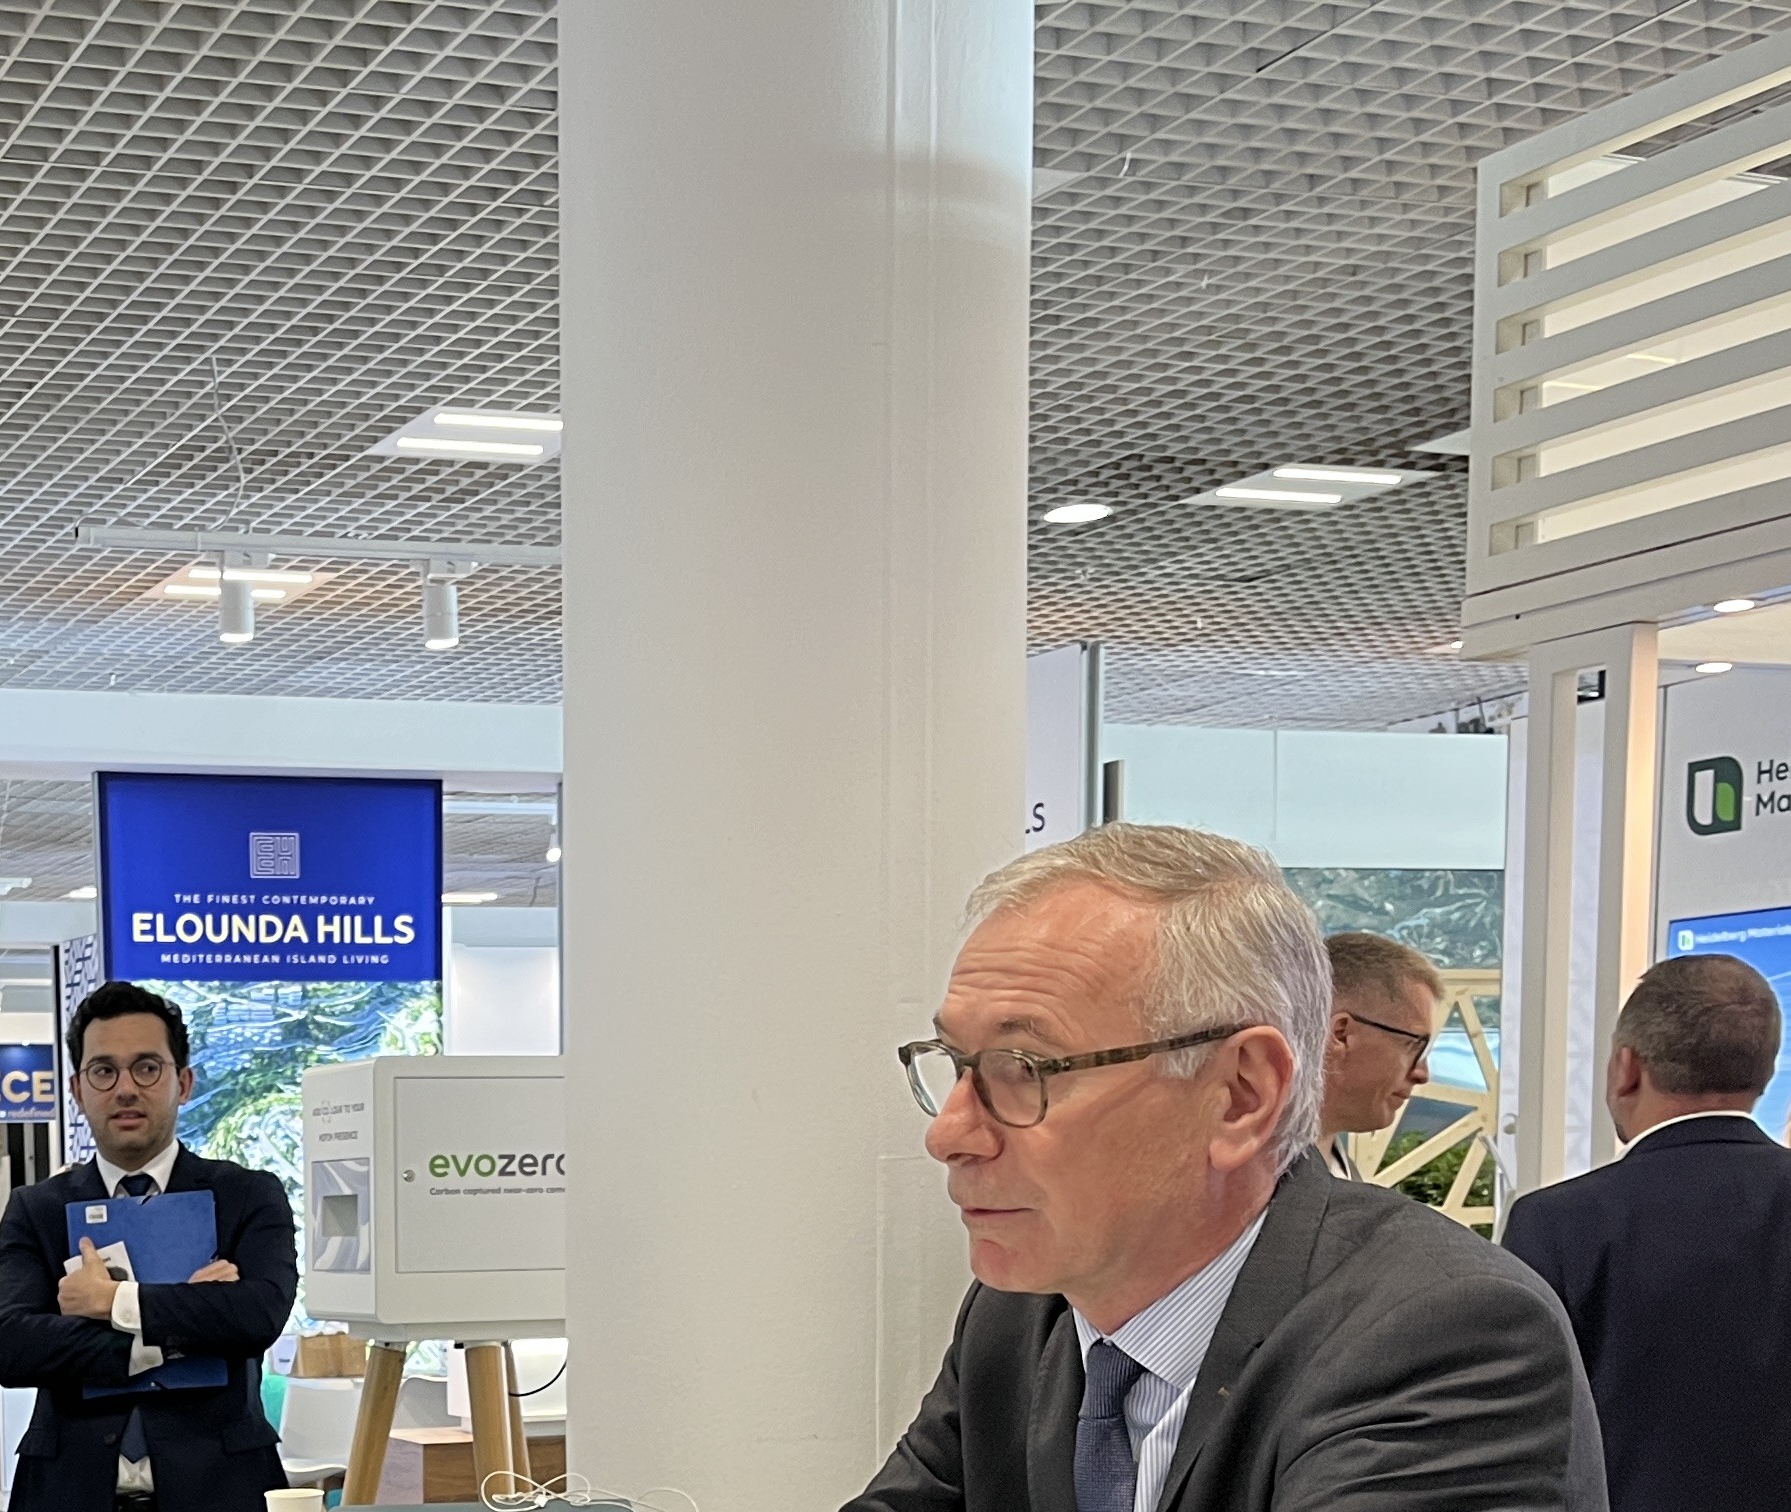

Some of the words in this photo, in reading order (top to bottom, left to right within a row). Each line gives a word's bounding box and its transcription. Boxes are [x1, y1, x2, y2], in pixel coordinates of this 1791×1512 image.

[174, 894, 200, 904] THE
[207, 894, 256, 905] FINEST
[262, 895, 375, 906] CONTEMPORARY
[132, 913, 309, 943] ELOUNDA
[317, 915, 415, 944] HILLS
[161, 953, 280, 964] MEDITERRANEAN
[286, 954, 337, 964] ISLAND
[343, 954, 389, 964] LIVING
